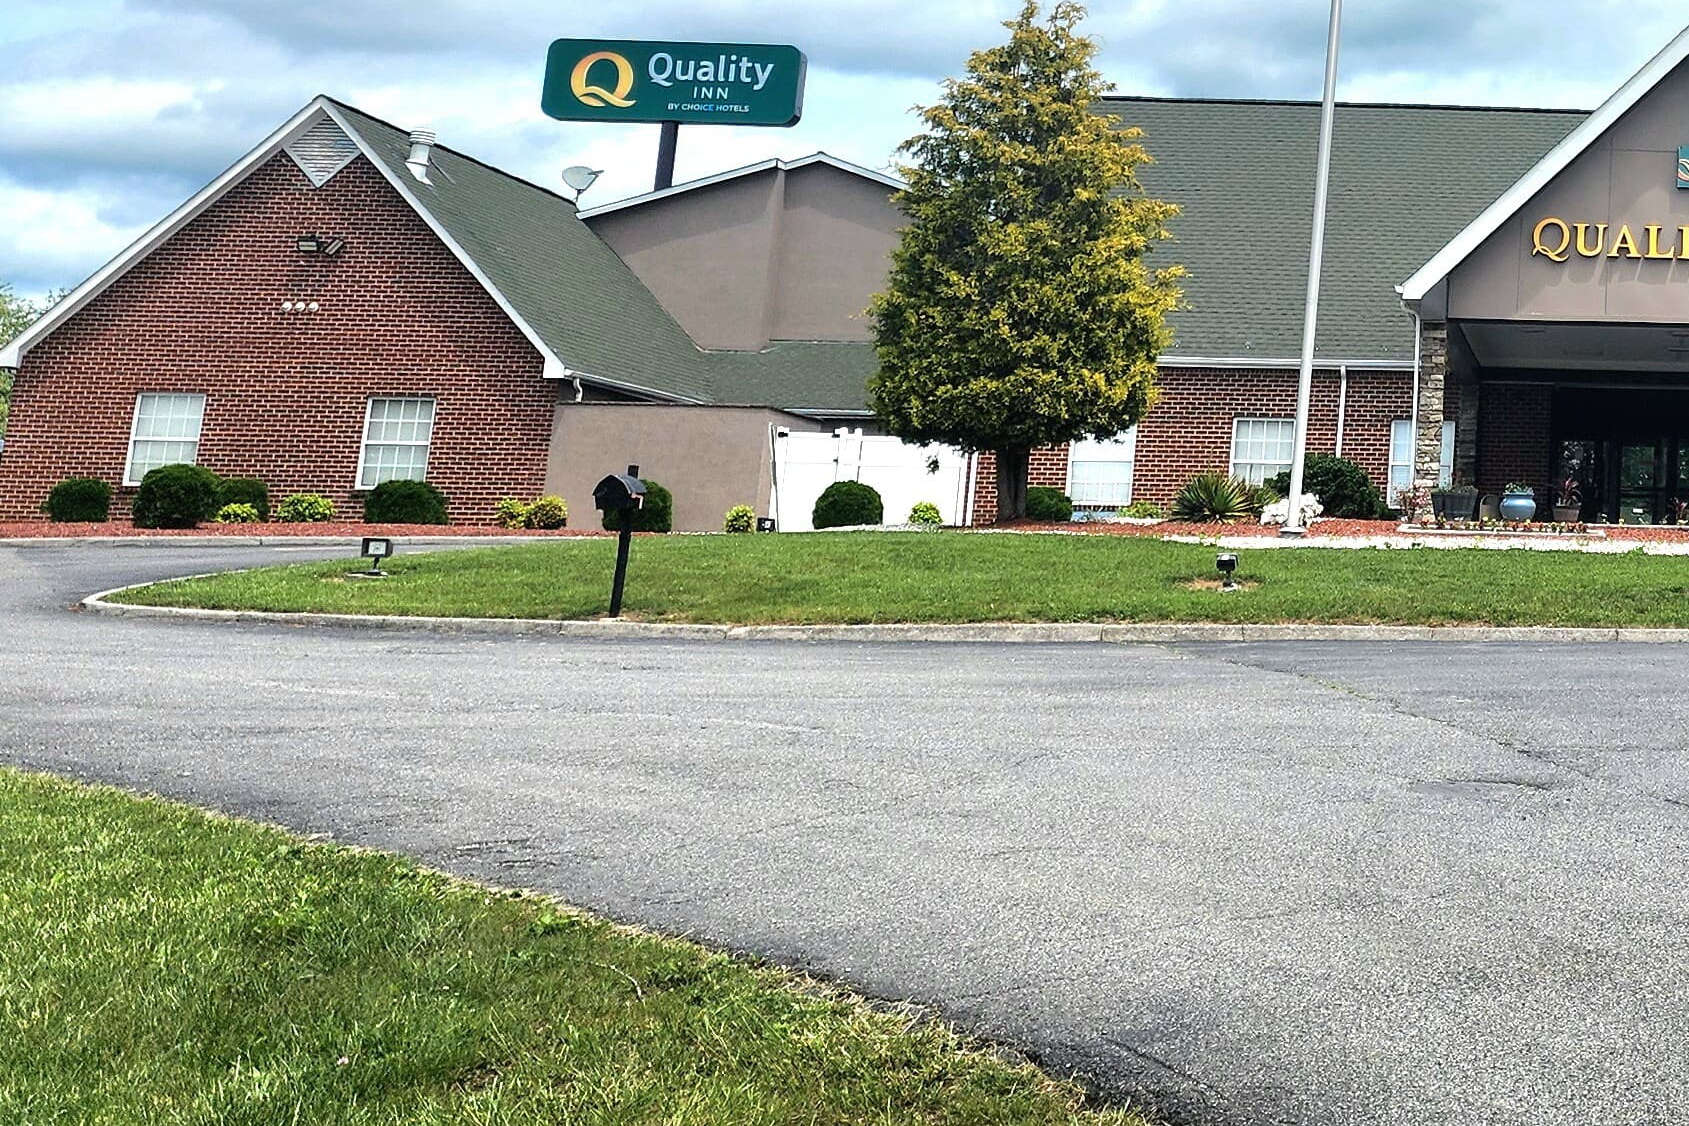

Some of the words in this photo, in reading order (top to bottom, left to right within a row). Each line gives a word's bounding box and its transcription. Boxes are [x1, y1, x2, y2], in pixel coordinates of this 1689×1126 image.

[648, 52, 775, 91] Quality
[693, 86, 729, 100] INN
[681, 103, 715, 112] CHOICE
[715, 104, 750, 113] HOTELS
